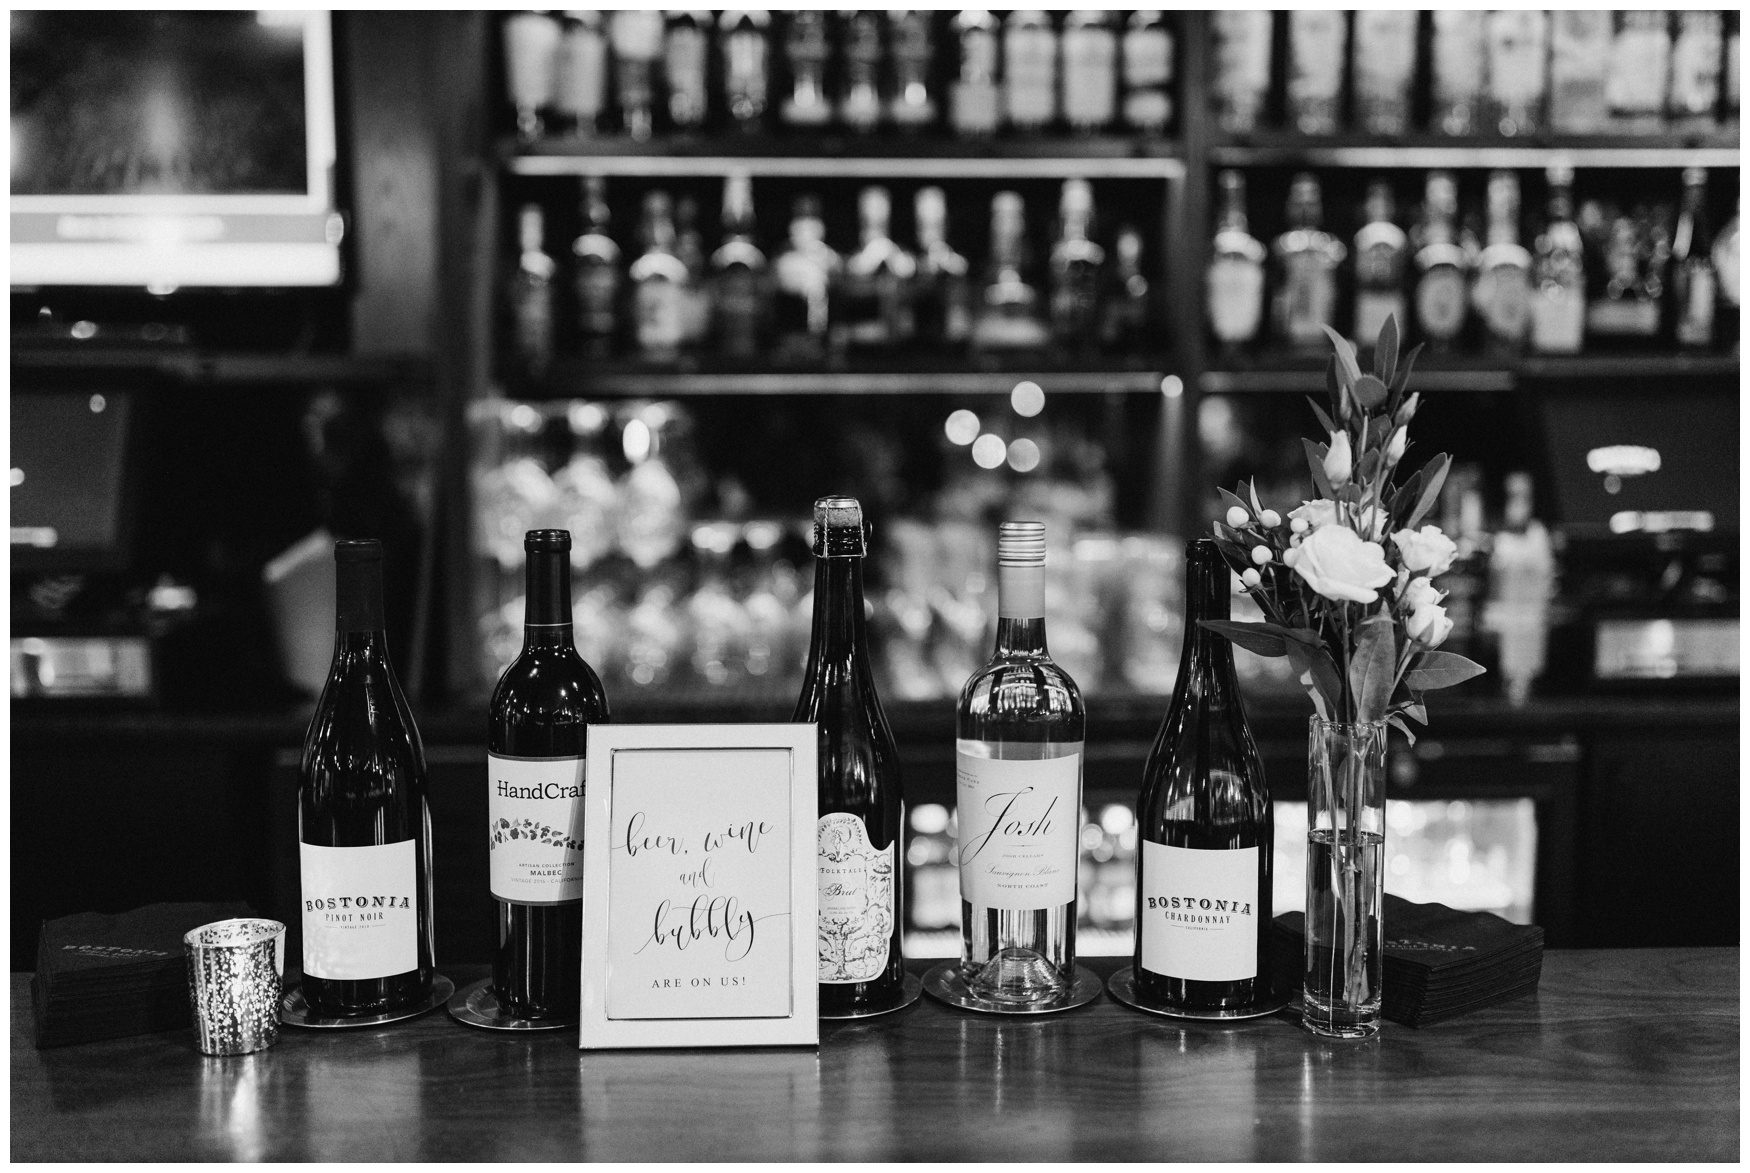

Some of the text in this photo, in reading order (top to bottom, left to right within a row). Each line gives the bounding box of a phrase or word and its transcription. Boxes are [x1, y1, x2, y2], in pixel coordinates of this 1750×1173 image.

[961, 786, 1058, 866] Josh
[704, 821, 774, 854] wine
[679, 856, 716, 889] and
[823, 882, 858, 901] Brut
[306, 896, 410, 912] BOSTONIA
[1148, 896, 1252, 916] BOSTONIA
[325, 911, 384, 922] PINOT NOIR
[1165, 911, 1231, 924] CHARDONNAY
[633, 893, 792, 962] bubbly
[651, 976, 747, 988] ARE ON US!
